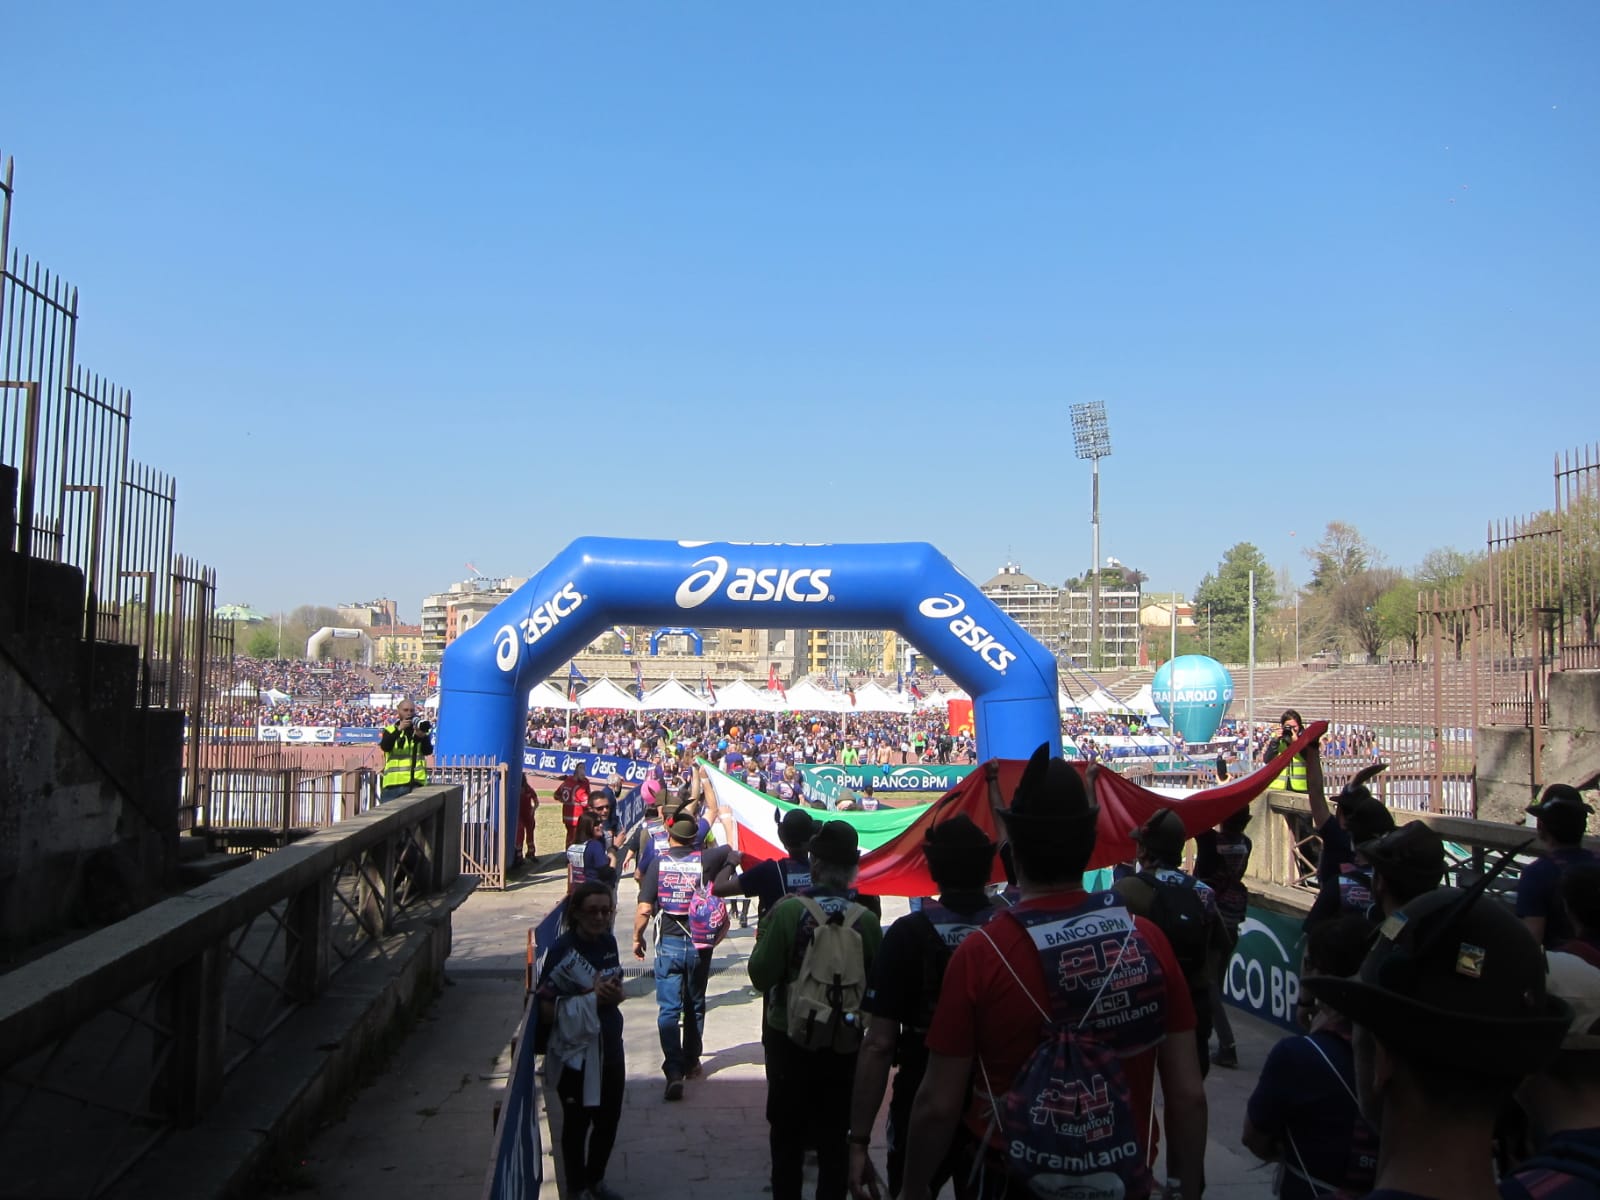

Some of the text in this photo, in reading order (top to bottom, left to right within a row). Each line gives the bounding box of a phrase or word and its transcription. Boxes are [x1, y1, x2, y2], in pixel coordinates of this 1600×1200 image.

[837, 776, 863, 788] BPM
[872, 776, 919, 788] BANCO
[922, 777, 947, 788] BPM
[1045, 919, 1127, 945] BANCO BPM
[1271, 965, 1300, 1022] BP
[1009, 1140, 1137, 1171] Stramilano
